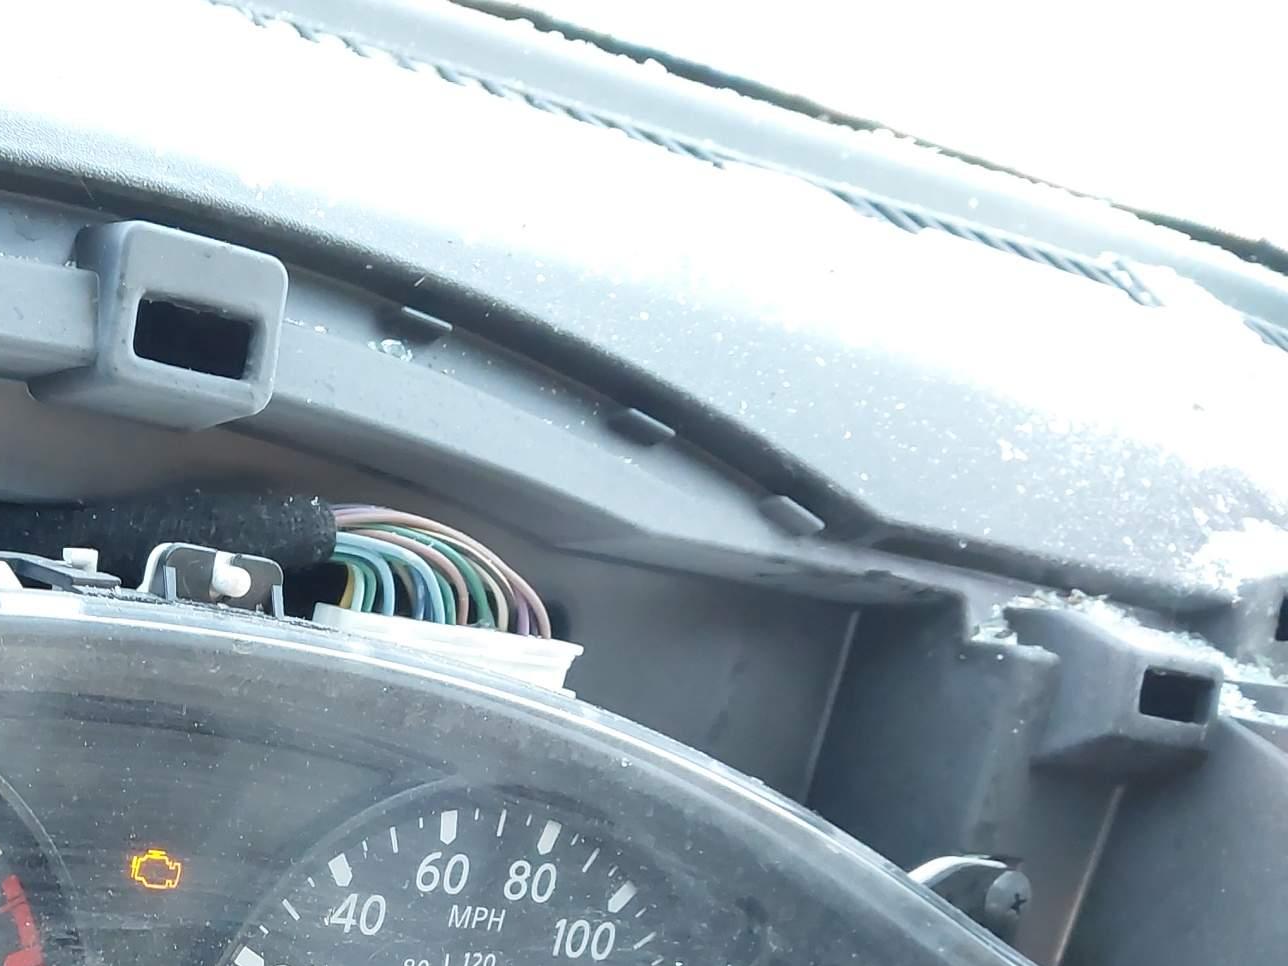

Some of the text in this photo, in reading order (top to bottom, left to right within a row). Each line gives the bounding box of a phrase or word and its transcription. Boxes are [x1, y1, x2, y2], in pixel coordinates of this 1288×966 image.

[416, 854, 469, 894] 60
[503, 860, 556, 902] 80
[330, 894, 386, 934] 40
[448, 906, 506, 932] MPH
[551, 919, 616, 960] 100
